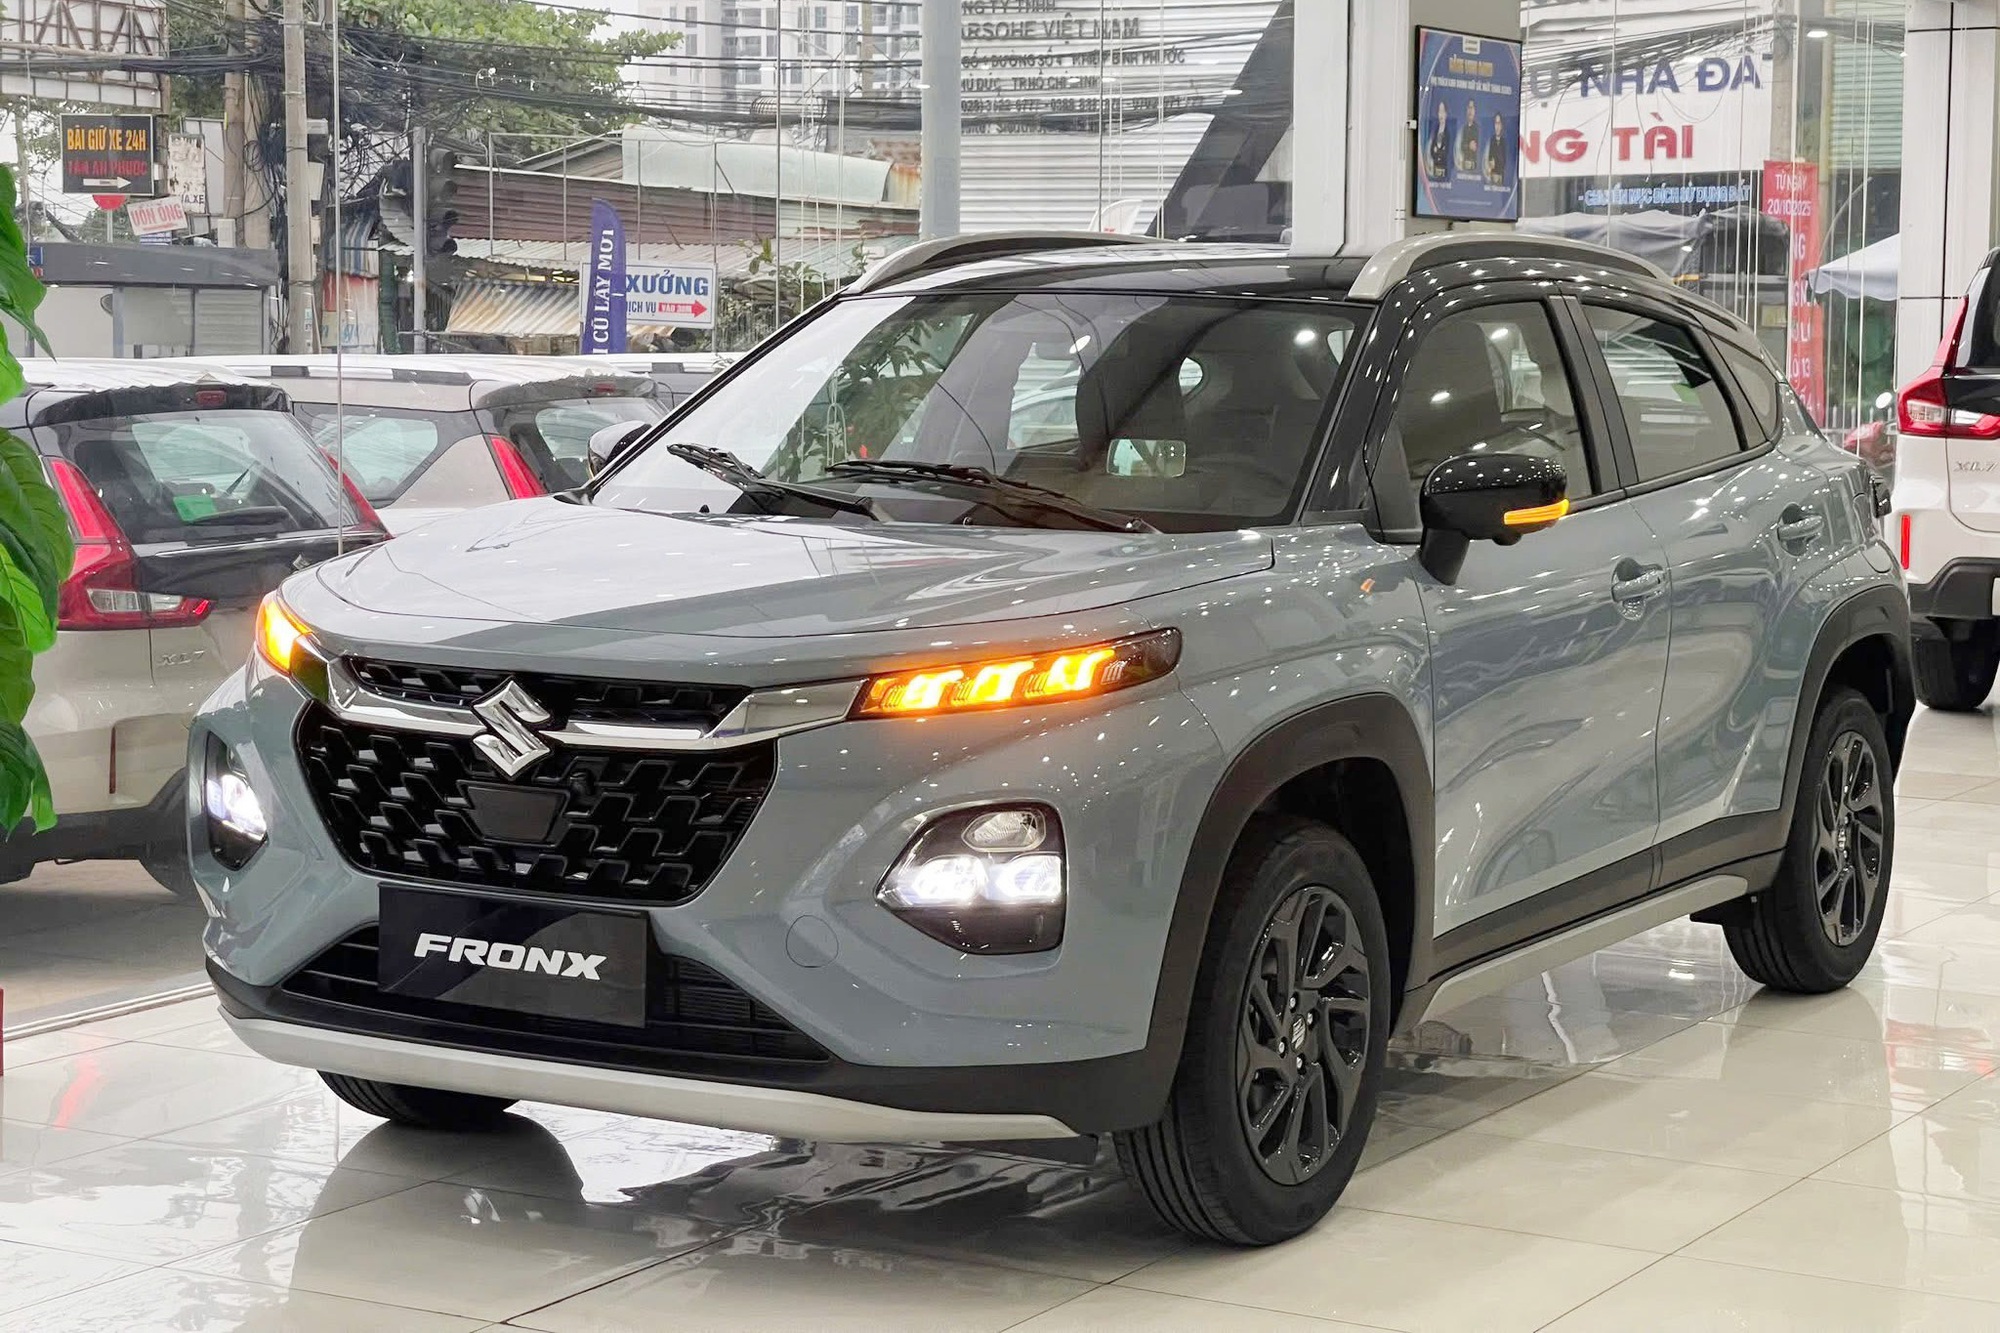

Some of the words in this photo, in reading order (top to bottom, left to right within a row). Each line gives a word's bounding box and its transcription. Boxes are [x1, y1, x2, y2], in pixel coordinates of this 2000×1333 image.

[1092, 17, 1139, 38] NAM
[88, 124, 107, 151] GIỮ
[109, 129, 123, 150] XE
[125, 129, 147, 151] 24H
[1612, 112, 1693, 162] TÀI
[626, 268, 710, 297] XƯỞNG
[645, 301, 657, 317] VỤ
[414, 932, 607, 981] FRONX
